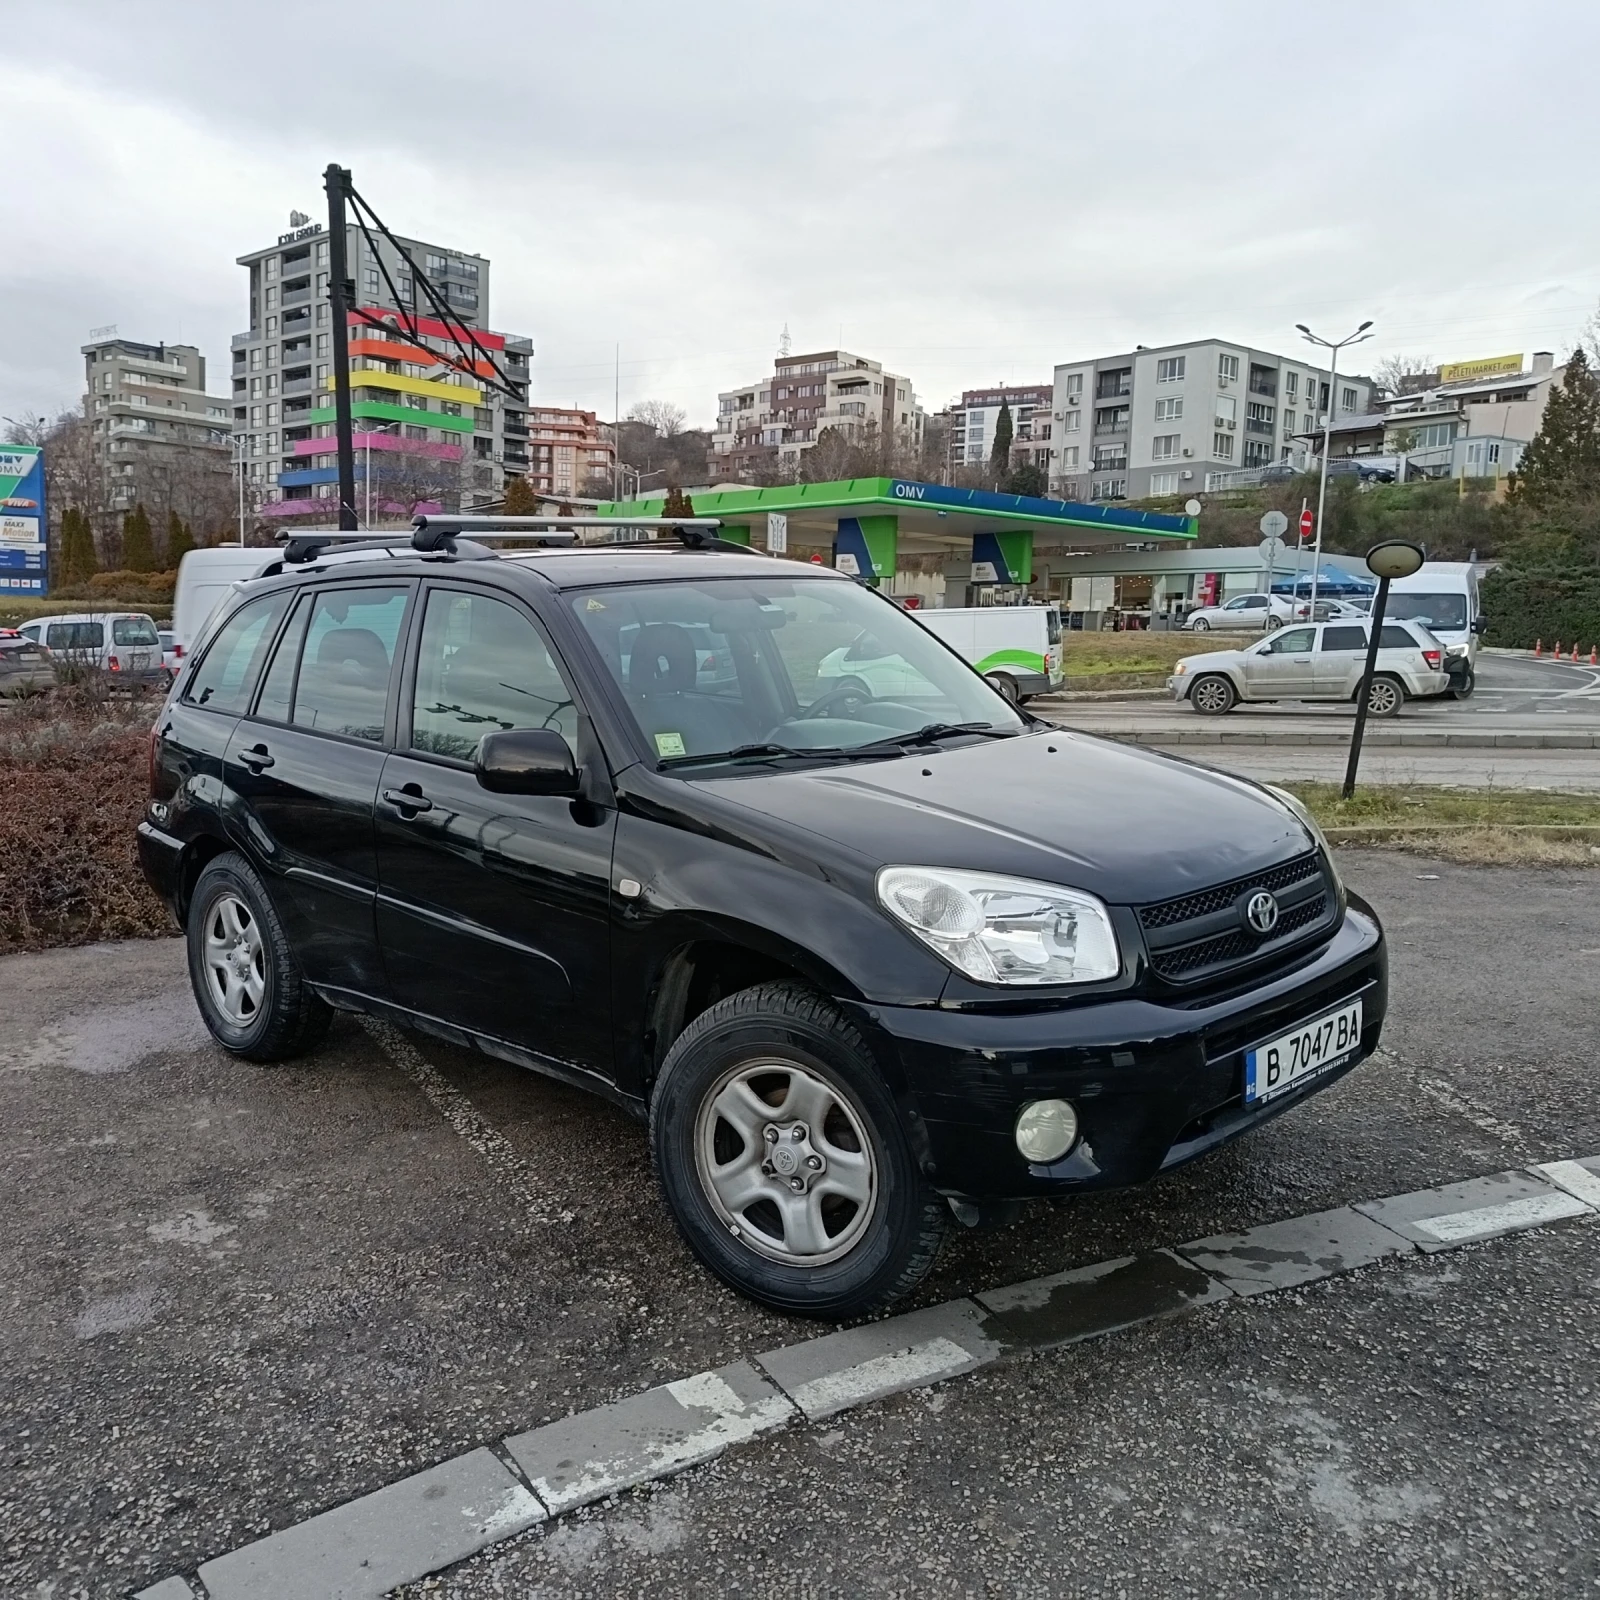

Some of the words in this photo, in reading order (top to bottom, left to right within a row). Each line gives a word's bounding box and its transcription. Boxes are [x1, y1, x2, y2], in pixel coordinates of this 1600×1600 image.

[0, 465, 23, 475] MV
[895, 484, 925, 499] OMV
[7, 499, 30, 508] VIVA
[2, 528, 35, 538] Motion
[1267, 1047, 1281, 1087] B
[1289, 1021, 1334, 1076] 7047
[1336, 1010, 1358, 1051] BA
[1246, 1082, 1256, 1096] BG
